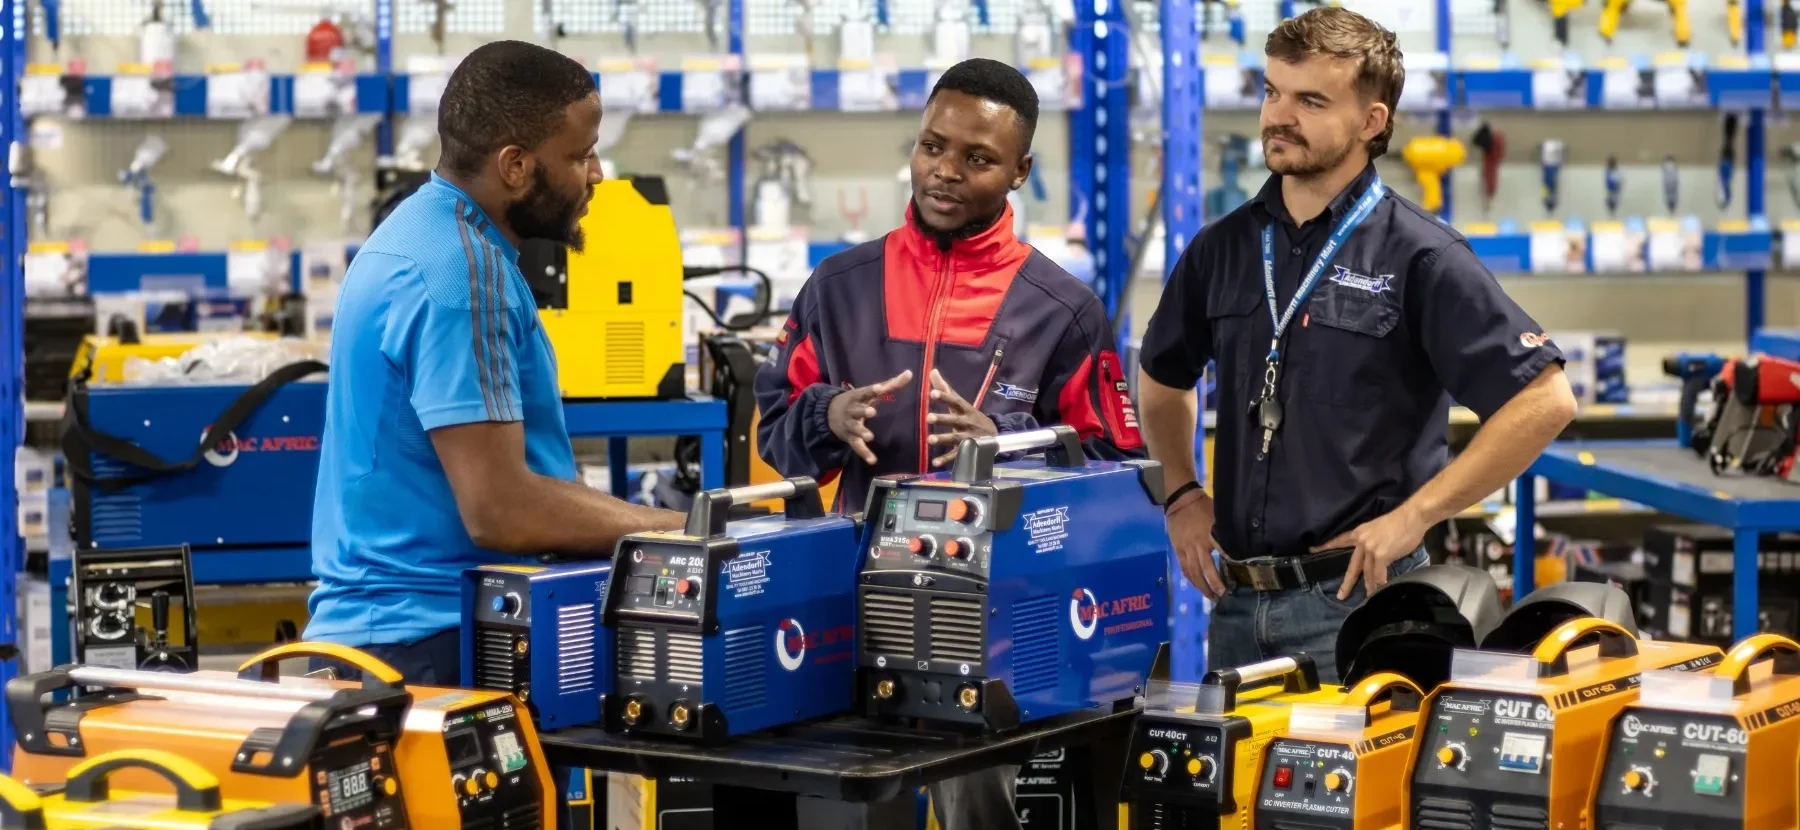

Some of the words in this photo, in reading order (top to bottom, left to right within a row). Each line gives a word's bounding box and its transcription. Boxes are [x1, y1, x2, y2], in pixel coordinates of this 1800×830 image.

[1296, 259, 1324, 299] Machinery
[1321, 239, 1337, 260] Mart
[1343, 274, 1382, 287] Adendorff
[217, 437, 258, 452] MAC
[260, 435, 319, 451] AFRIC
[669, 556, 687, 566] ARC
[1080, 601, 1109, 621] MAC
[1111, 593, 1151, 616] AFRIC
[1103, 618, 1154, 636] PROFESSIONAL
[1582, 683, 1617, 698] CUT-60
[1494, 699, 1533, 719] CUT
[1535, 703, 1555, 721] 60
[1683, 722, 1749, 745] CUT-60
[1317, 748, 1355, 761] CUT-40
[1273, 800, 1302, 808] INVERTER
[1301, 803, 1325, 812] PLASMA
[1325, 805, 1350, 814] CUTTER
